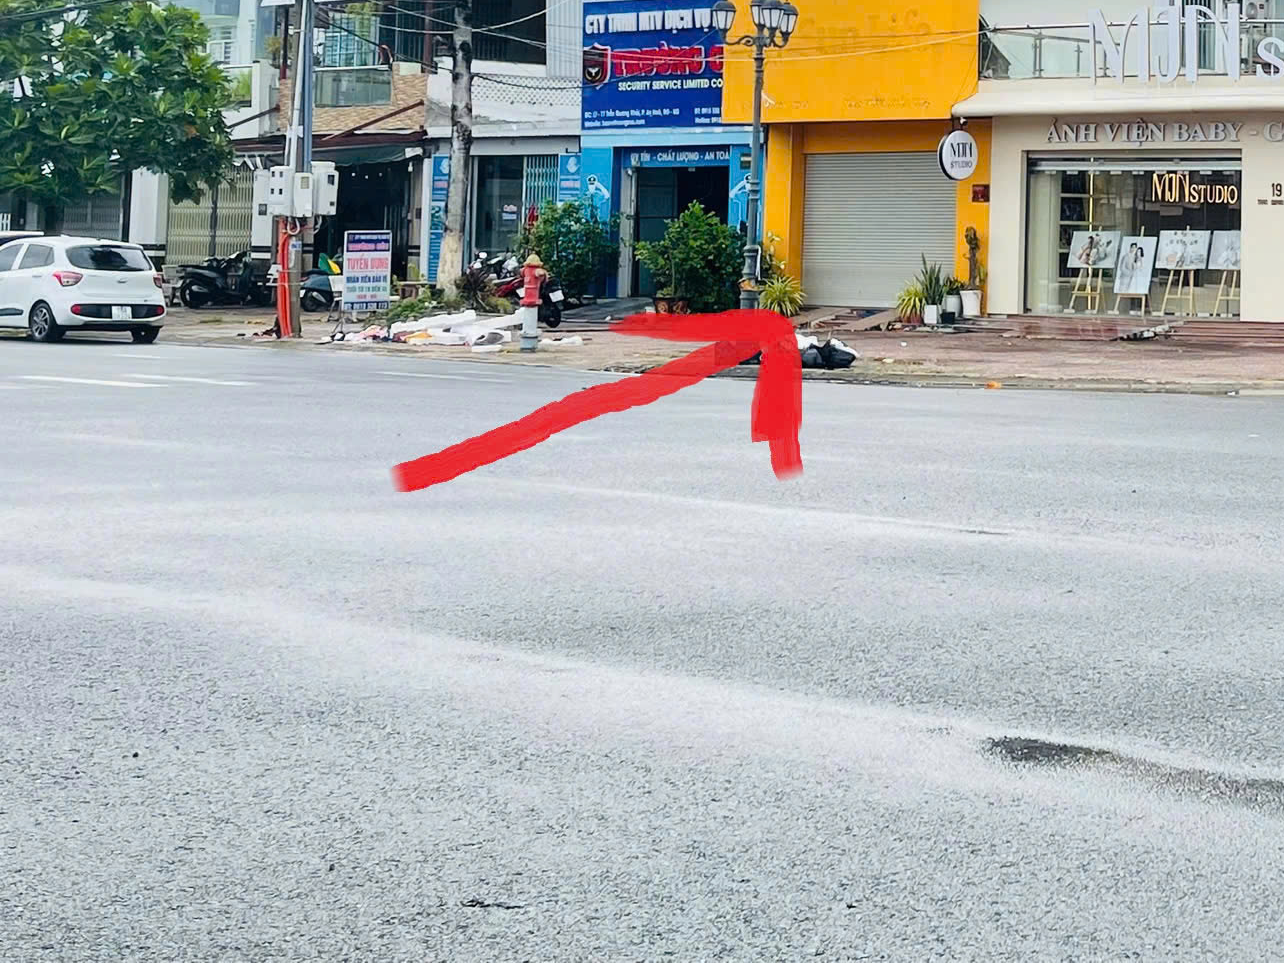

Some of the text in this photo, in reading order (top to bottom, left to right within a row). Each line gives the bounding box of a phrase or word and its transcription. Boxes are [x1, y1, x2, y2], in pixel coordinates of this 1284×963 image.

[618, 80, 650, 91] SECURITY
[652, 79, 681, 90] SERVICE
[683, 78, 709, 90] LIMITED
[1047, 118, 1099, 143] ẢNH
[1104, 118, 1166, 147] VIỆN
[1172, 121, 1243, 143] BABY
[704, 151, 714, 160] AN
[715, 150, 730, 160] TOÀ
[1189, 184, 1238, 204] STUDIO
[1271, 183, 1282, 197] 19
